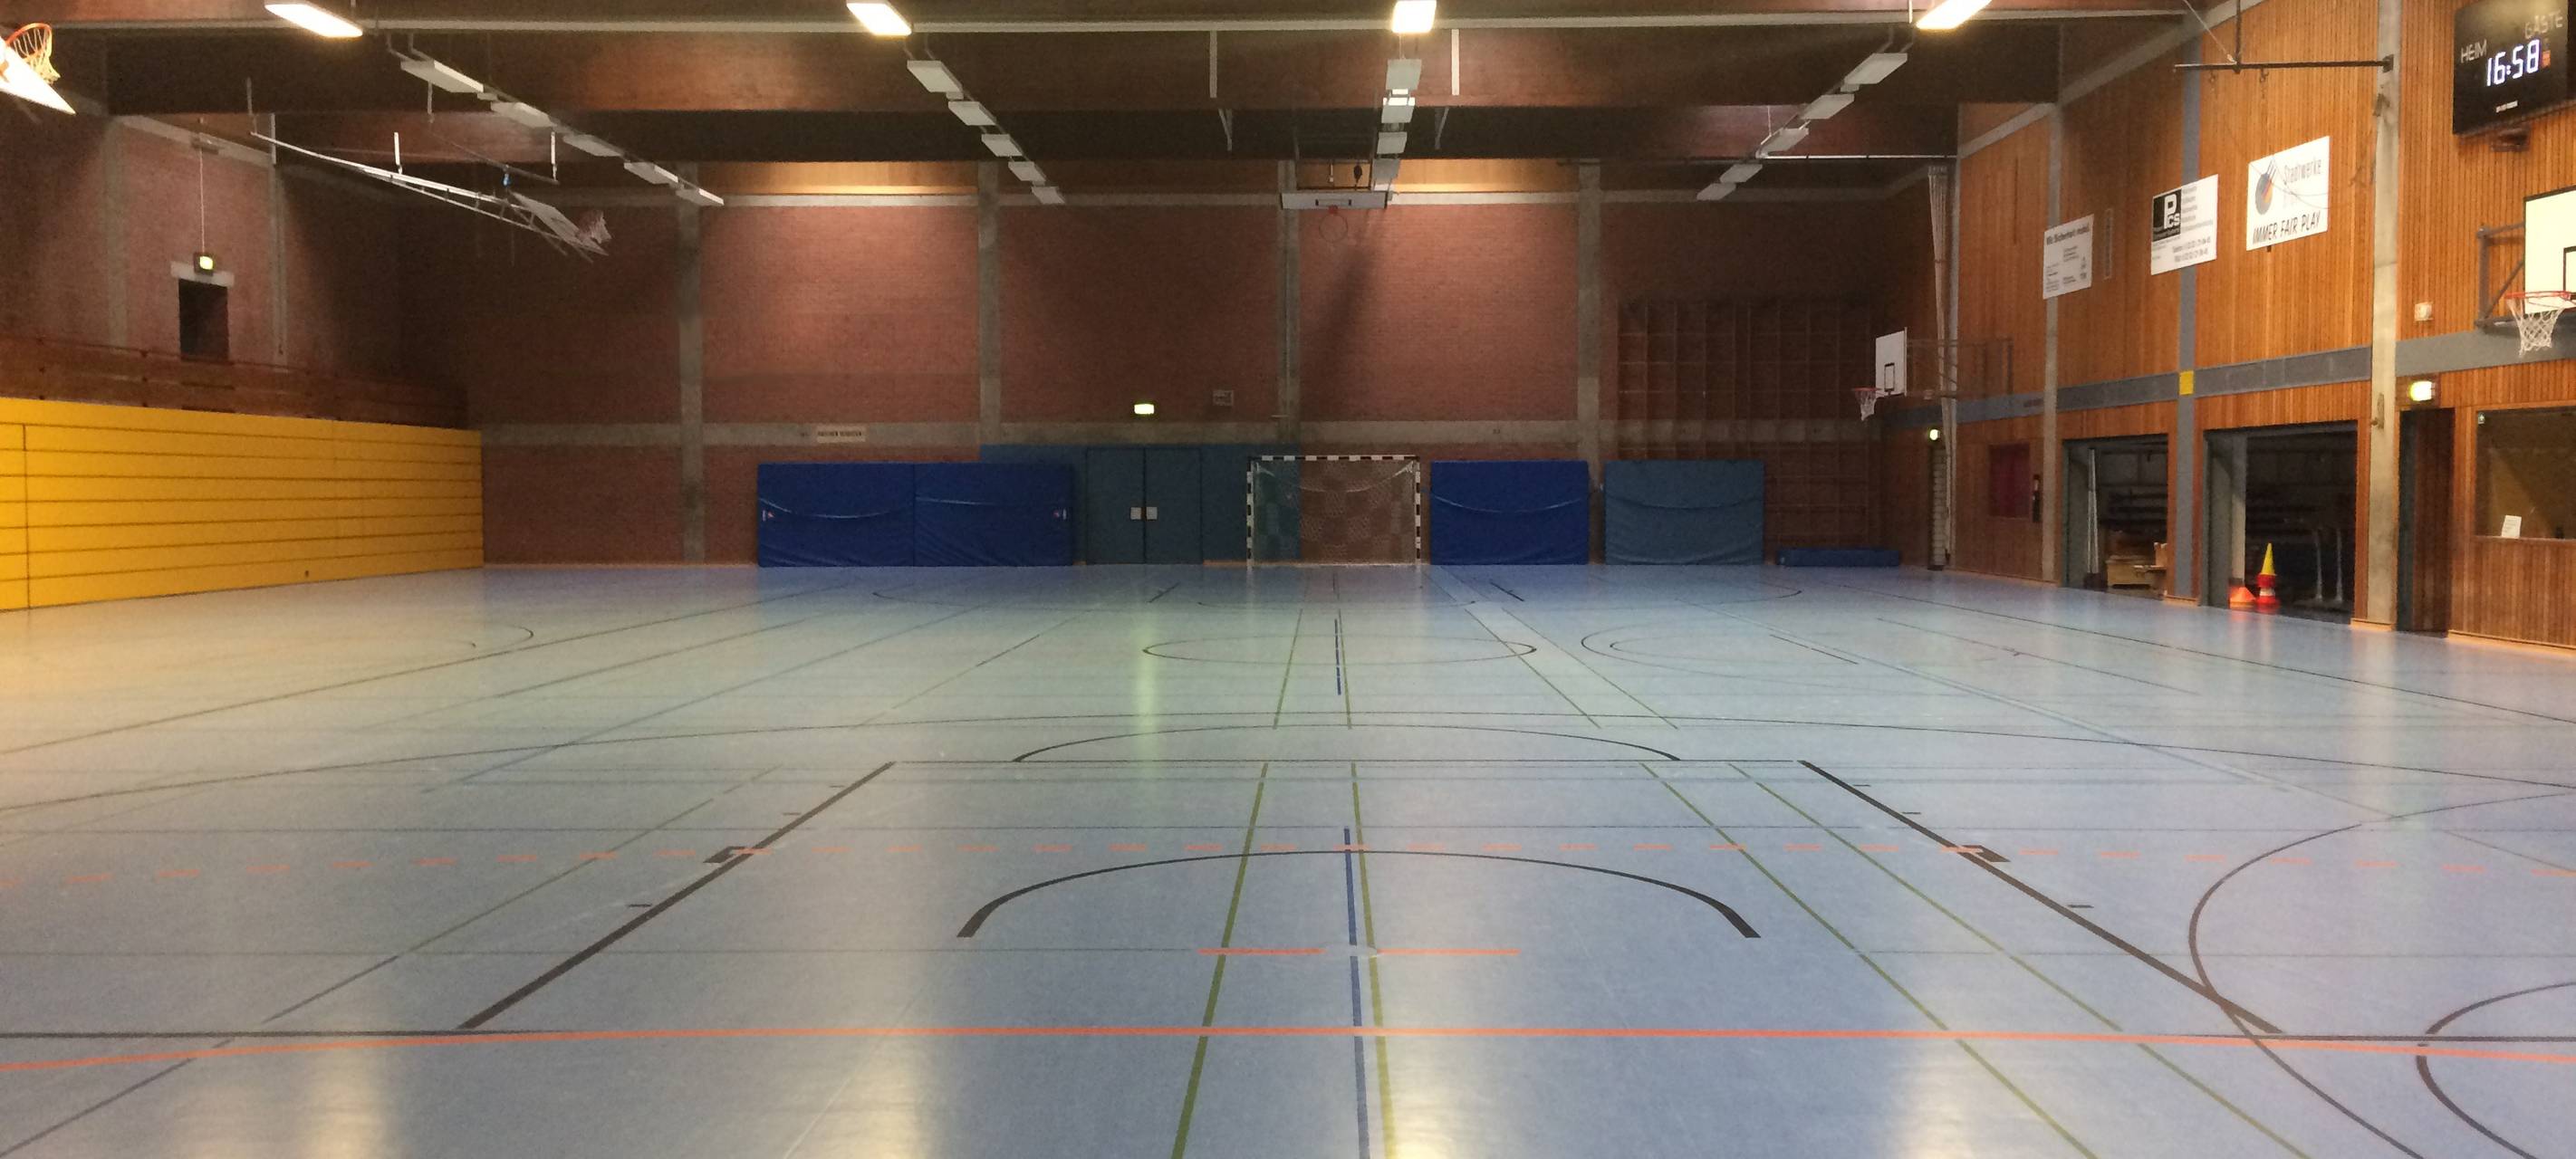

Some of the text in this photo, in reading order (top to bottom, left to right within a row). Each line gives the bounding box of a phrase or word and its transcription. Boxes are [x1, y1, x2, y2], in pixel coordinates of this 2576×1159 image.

[2460, 39, 2487, 63] HEIM
[2486, 39, 2540, 87] 16:58
[2253, 210, 2321, 244] IMMER FAIR PLAY
